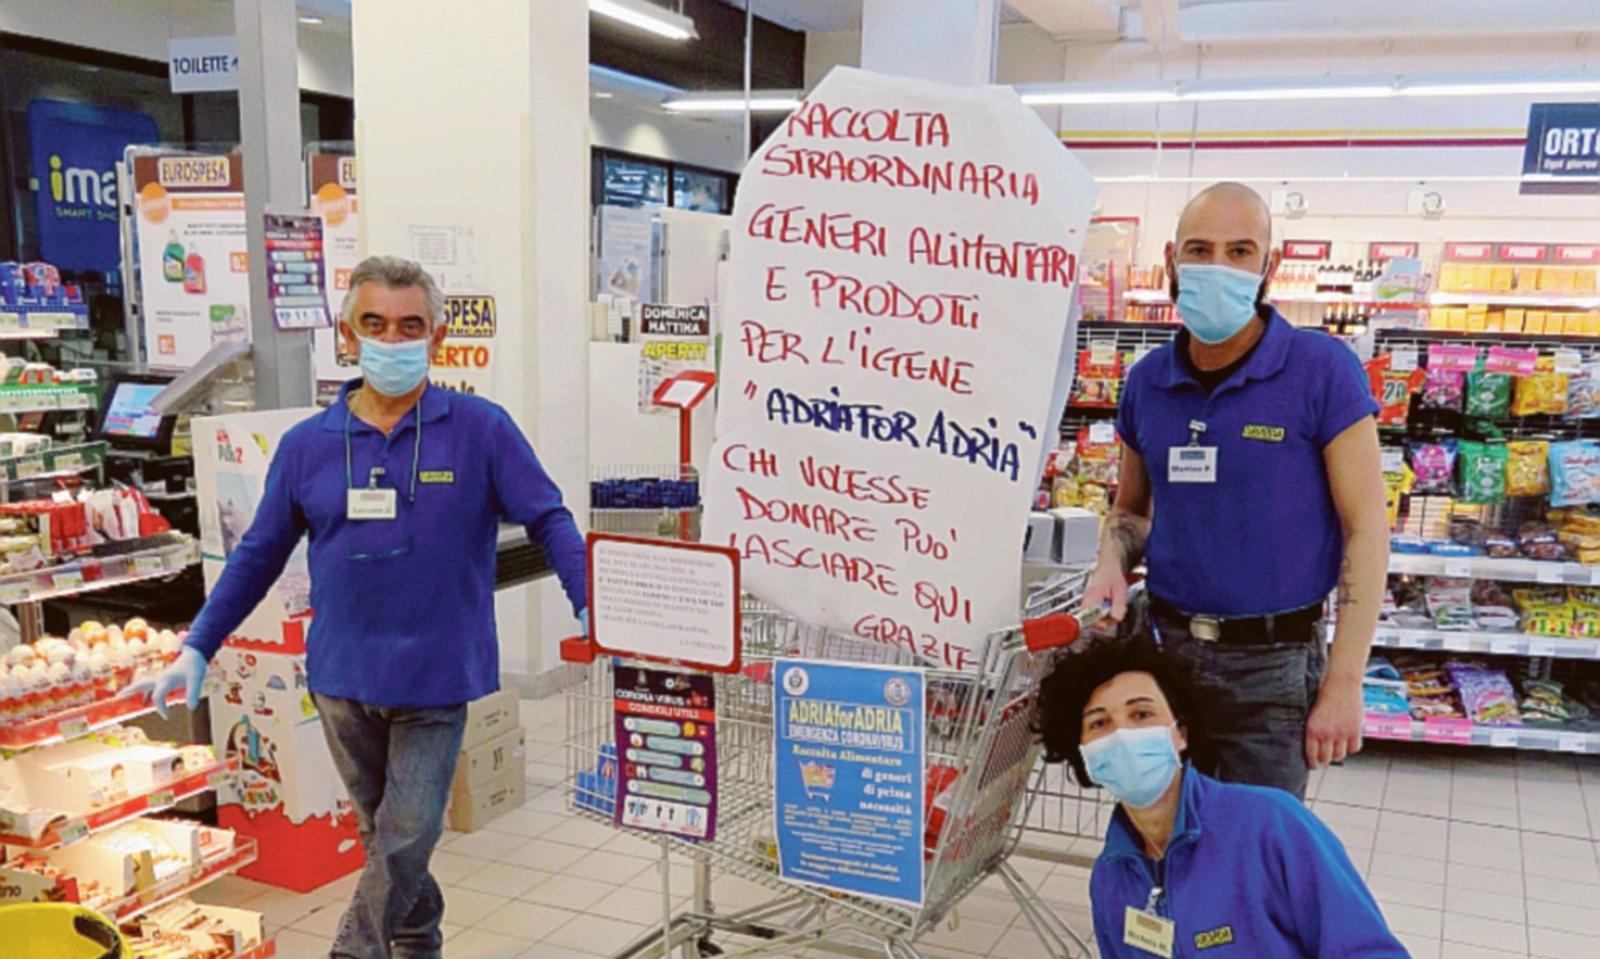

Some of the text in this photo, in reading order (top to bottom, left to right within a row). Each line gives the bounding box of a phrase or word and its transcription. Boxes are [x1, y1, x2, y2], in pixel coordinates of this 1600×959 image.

[173, 55, 229, 75] TOILETTE
[162, 161, 227, 183] EUROSPESA
[762, 144, 1039, 205] STRAORDINARIA
[749, 203, 886, 257] GENERI
[765, 266, 787, 301] E
[644, 307, 707, 321] DOMENICA
[648, 320, 701, 335] MATTINA
[741, 320, 810, 365] PER
[723, 444, 931, 510] CHI VOLESSE
[736, 486, 878, 542] DONARE
[915, 582, 972, 624] QUI
[616, 689, 684, 706] CORONA VIRUS
[789, 724, 839, 744] EMERGENZA
[790, 700, 903, 734] ADRIAforADRIA
